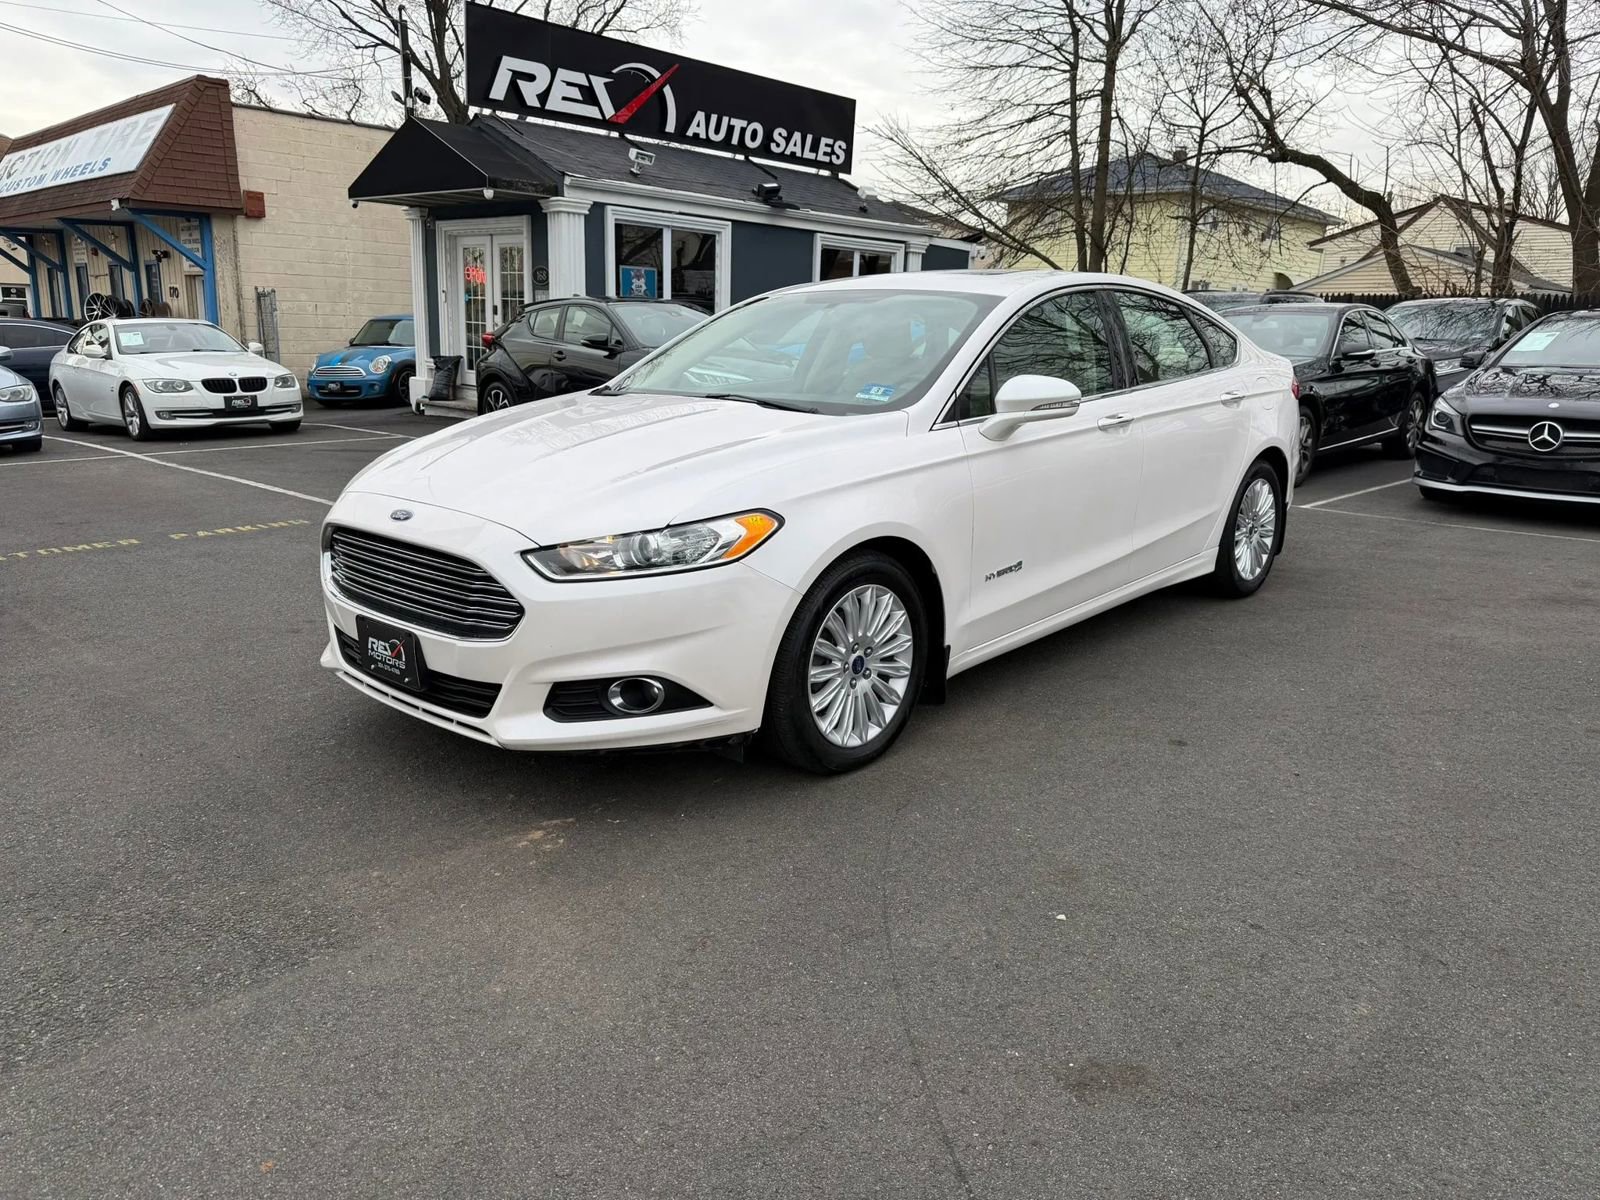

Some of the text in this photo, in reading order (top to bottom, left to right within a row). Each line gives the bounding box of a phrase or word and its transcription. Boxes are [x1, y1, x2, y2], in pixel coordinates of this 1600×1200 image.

[489, 55, 680, 125] REV
[90, 112, 164, 156] TIRE
[686, 110, 848, 166] AUTO SALES
[0, 157, 112, 194] CUSTOM WHEELS
[0, 519, 310, 561] TOMER PARKING
[368, 637, 405, 657] REV
[368, 649, 406, 670] MOTORS
